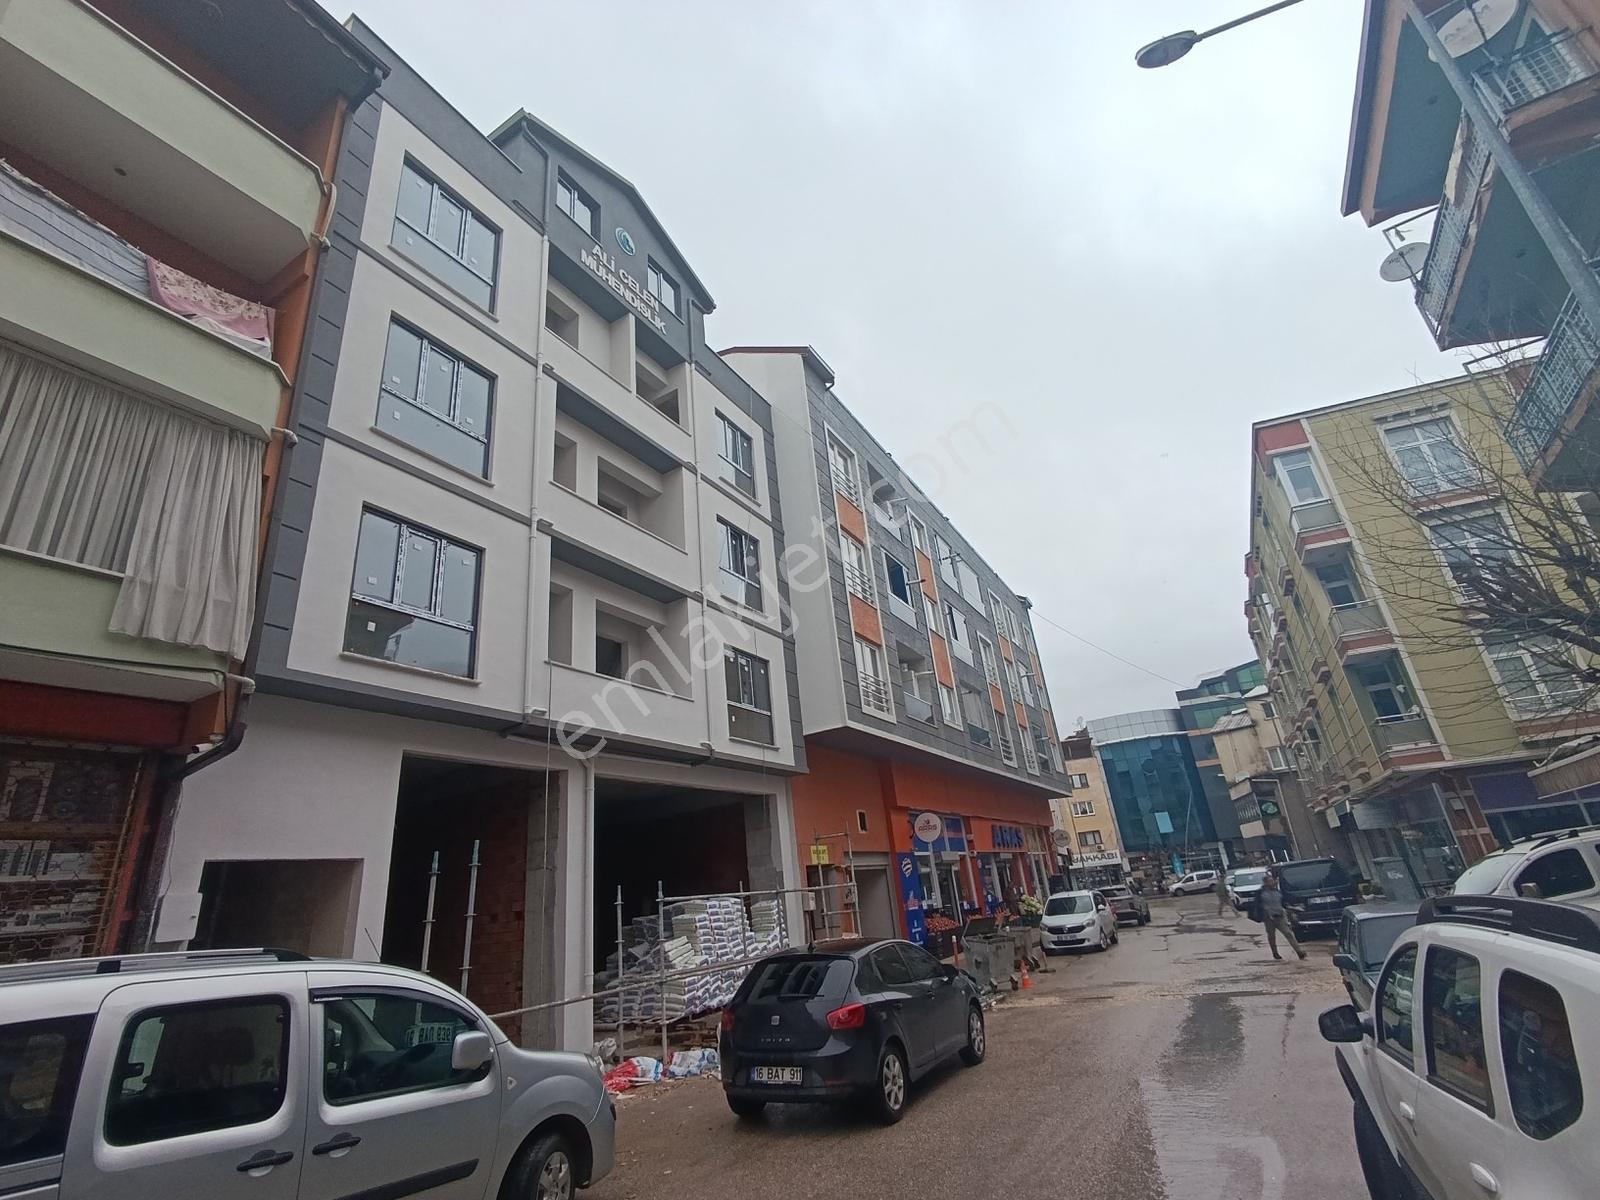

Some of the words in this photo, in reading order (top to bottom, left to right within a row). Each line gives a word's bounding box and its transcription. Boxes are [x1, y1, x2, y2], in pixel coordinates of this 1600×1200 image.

[756, 1068, 763, 1080] 16
[767, 1068, 785, 1080] BAT
[790, 1068, 801, 1081] 911
